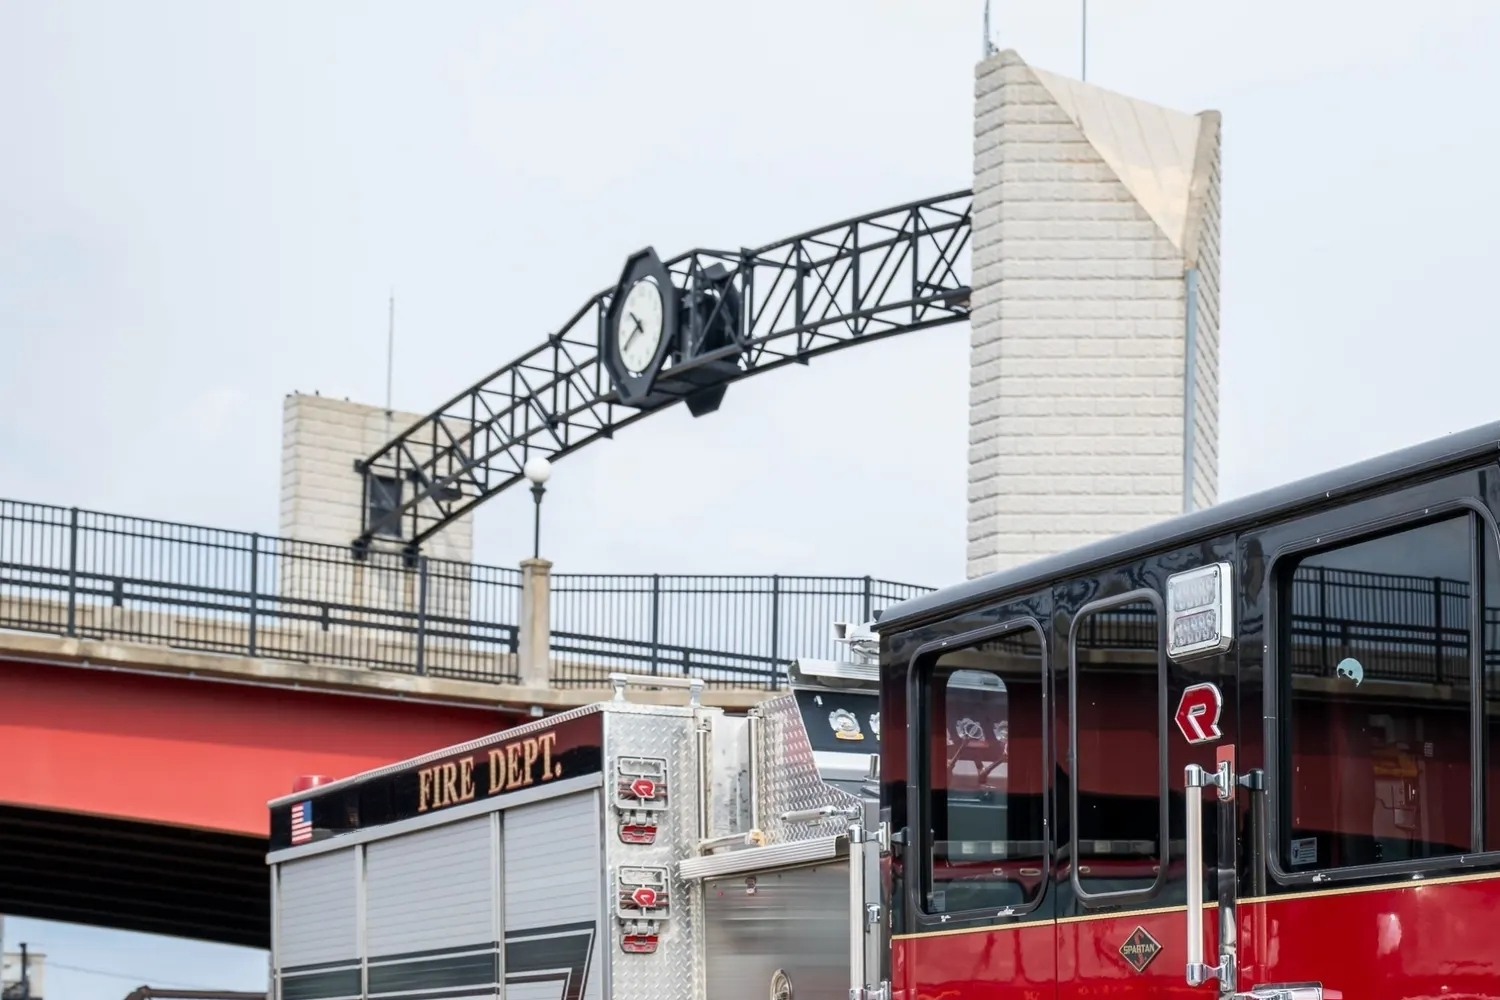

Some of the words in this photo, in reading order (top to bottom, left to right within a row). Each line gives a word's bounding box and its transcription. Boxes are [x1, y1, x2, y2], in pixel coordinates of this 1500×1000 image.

[417, 756, 476, 812] FIRE
[487, 732, 562, 795] DEPT.
[1123, 943, 1155, 955] SPARTAN
